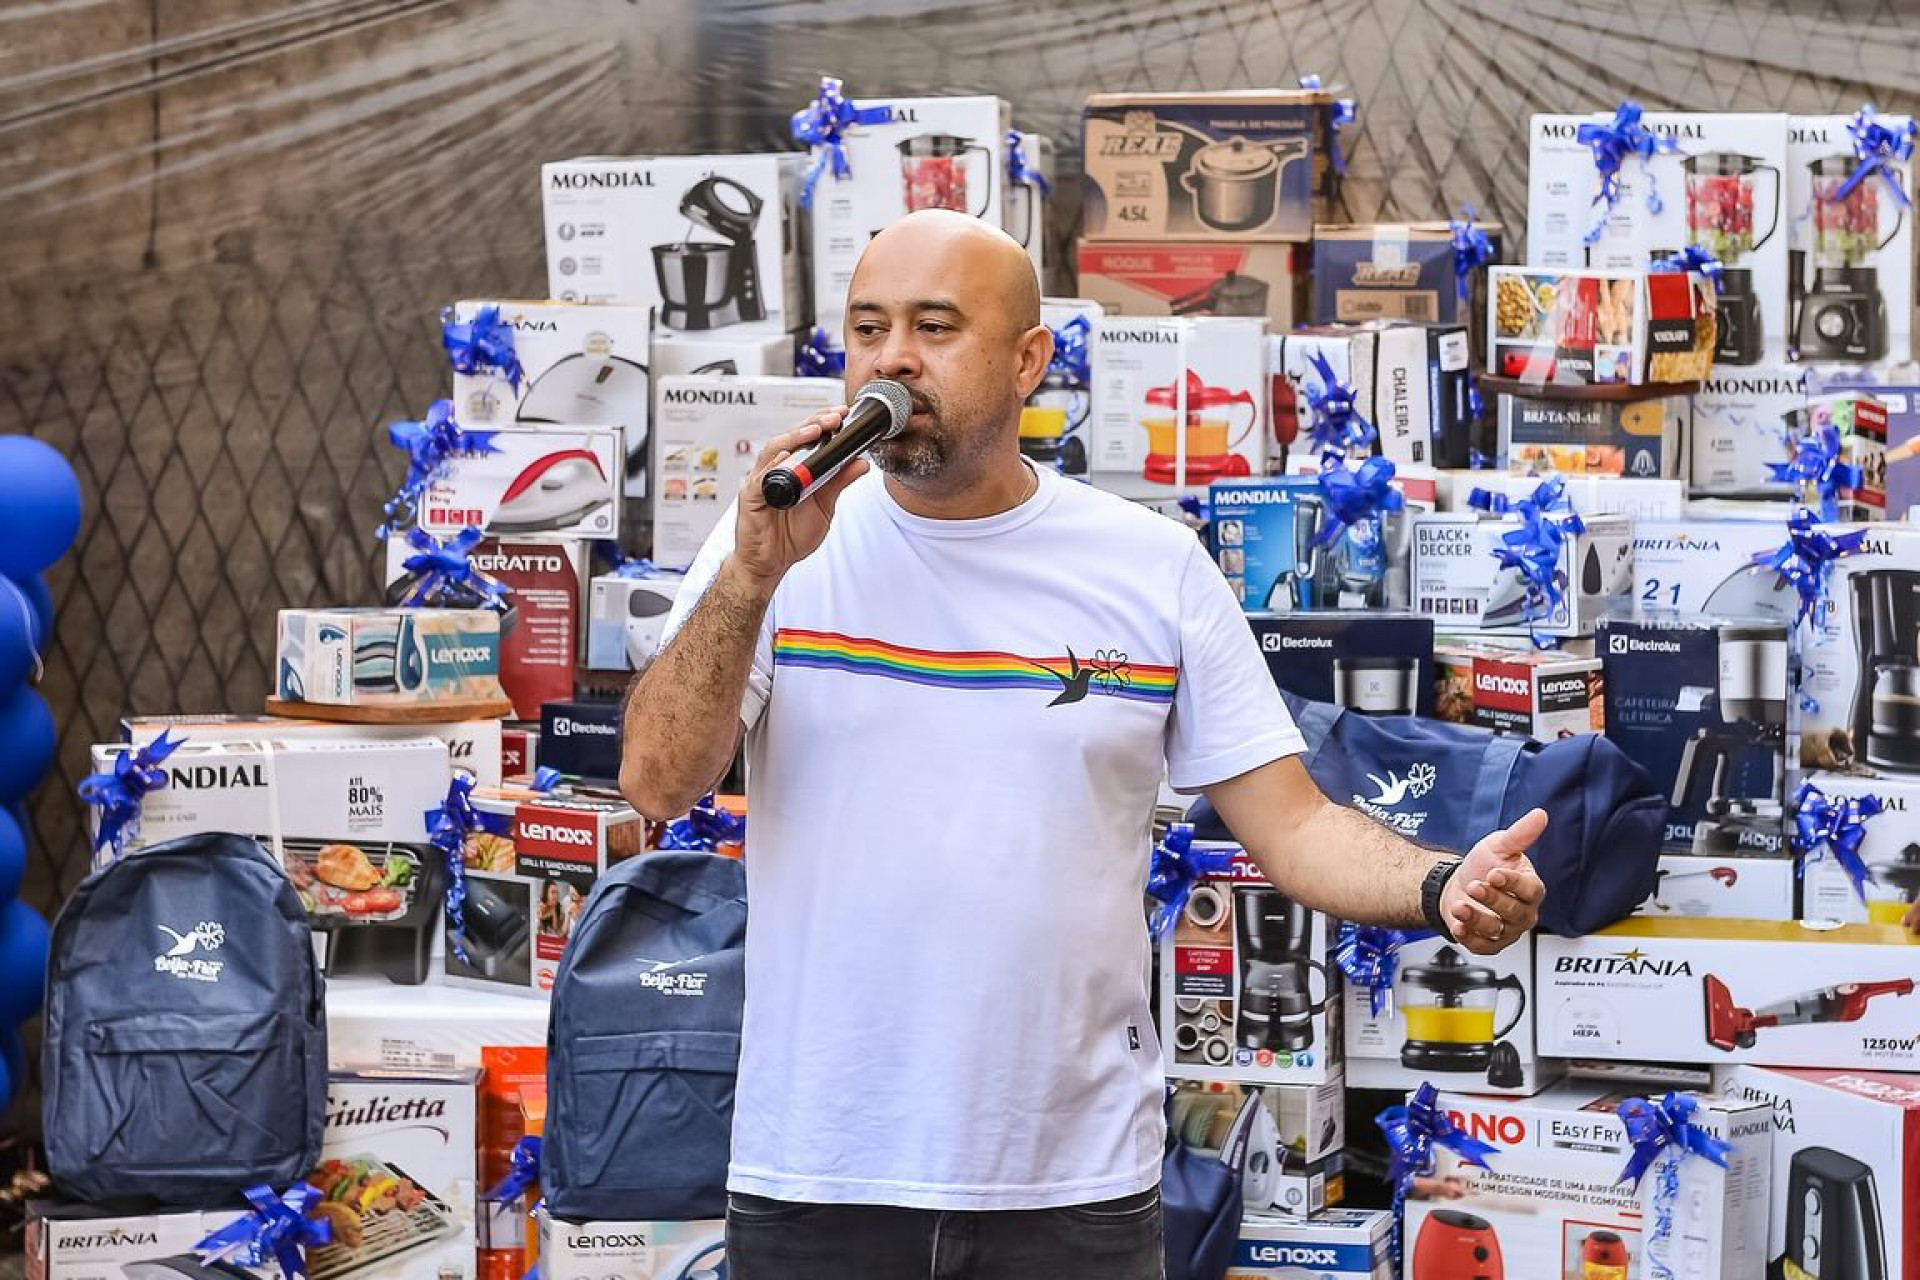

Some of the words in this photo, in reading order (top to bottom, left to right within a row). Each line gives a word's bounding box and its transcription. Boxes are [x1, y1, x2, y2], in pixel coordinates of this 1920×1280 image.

[1788, 129, 1830, 144] DIAL
[550, 171, 655, 189] MONDIAL
[664, 389, 757, 405] MONDIAL
[1393, 368, 1409, 437] CHALEIRA
[1215, 489, 1290, 505] MONDIAL
[1419, 529, 1470, 541] BLACK+
[1419, 543, 1472, 556] DECKER
[1642, 579, 1660, 601] 2
[1669, 584, 1682, 606] 1
[1283, 637, 1334, 648] Electrolux
[1629, 638, 1681, 653] Electrolux
[171, 764, 269, 790] NDIAL
[348, 787, 384, 804] 80%
[348, 806, 384, 817] MAIS
[1573, 1029, 1600, 1037] HEPA
[1863, 1038, 1915, 1050] 1250W
[1487, 1171, 1549, 1186] PRATICIDADE
[1564, 1181, 1586, 1192] UMA
[1466, 1180, 1479, 1190] EM
[1482, 1184, 1497, 1193] UM
[1497, 1185, 1533, 1196] DESIGN
[1534, 1189, 1581, 1203] MODERNO
[1589, 1195, 1641, 1210] COMPACTO
